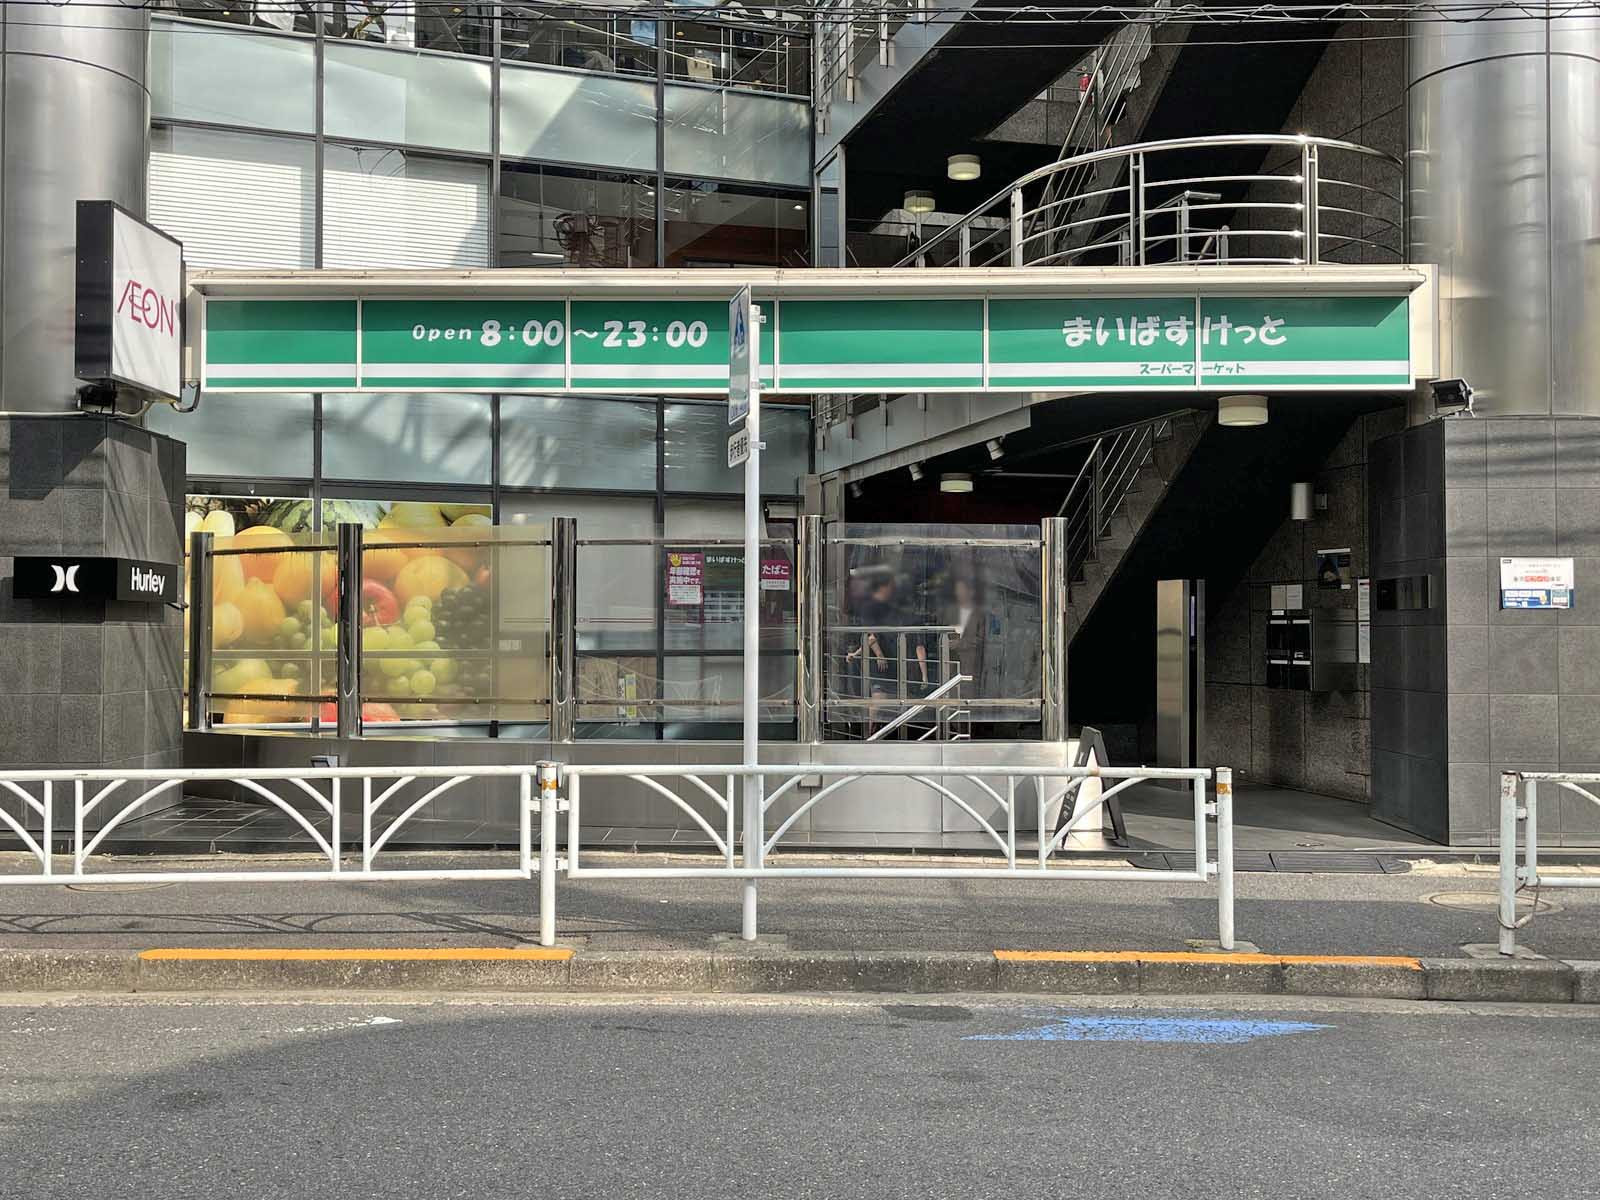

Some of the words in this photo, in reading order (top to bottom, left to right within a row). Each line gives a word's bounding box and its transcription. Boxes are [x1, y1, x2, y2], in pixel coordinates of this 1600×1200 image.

[412, 324, 472, 341] Open
[1062, 315, 1288, 347] まいばすけっと
[1140, 363, 1246, 375] スーパーマーケット
[761, 564, 790, 575] たばこ
[131, 567, 166, 596] Hurley
